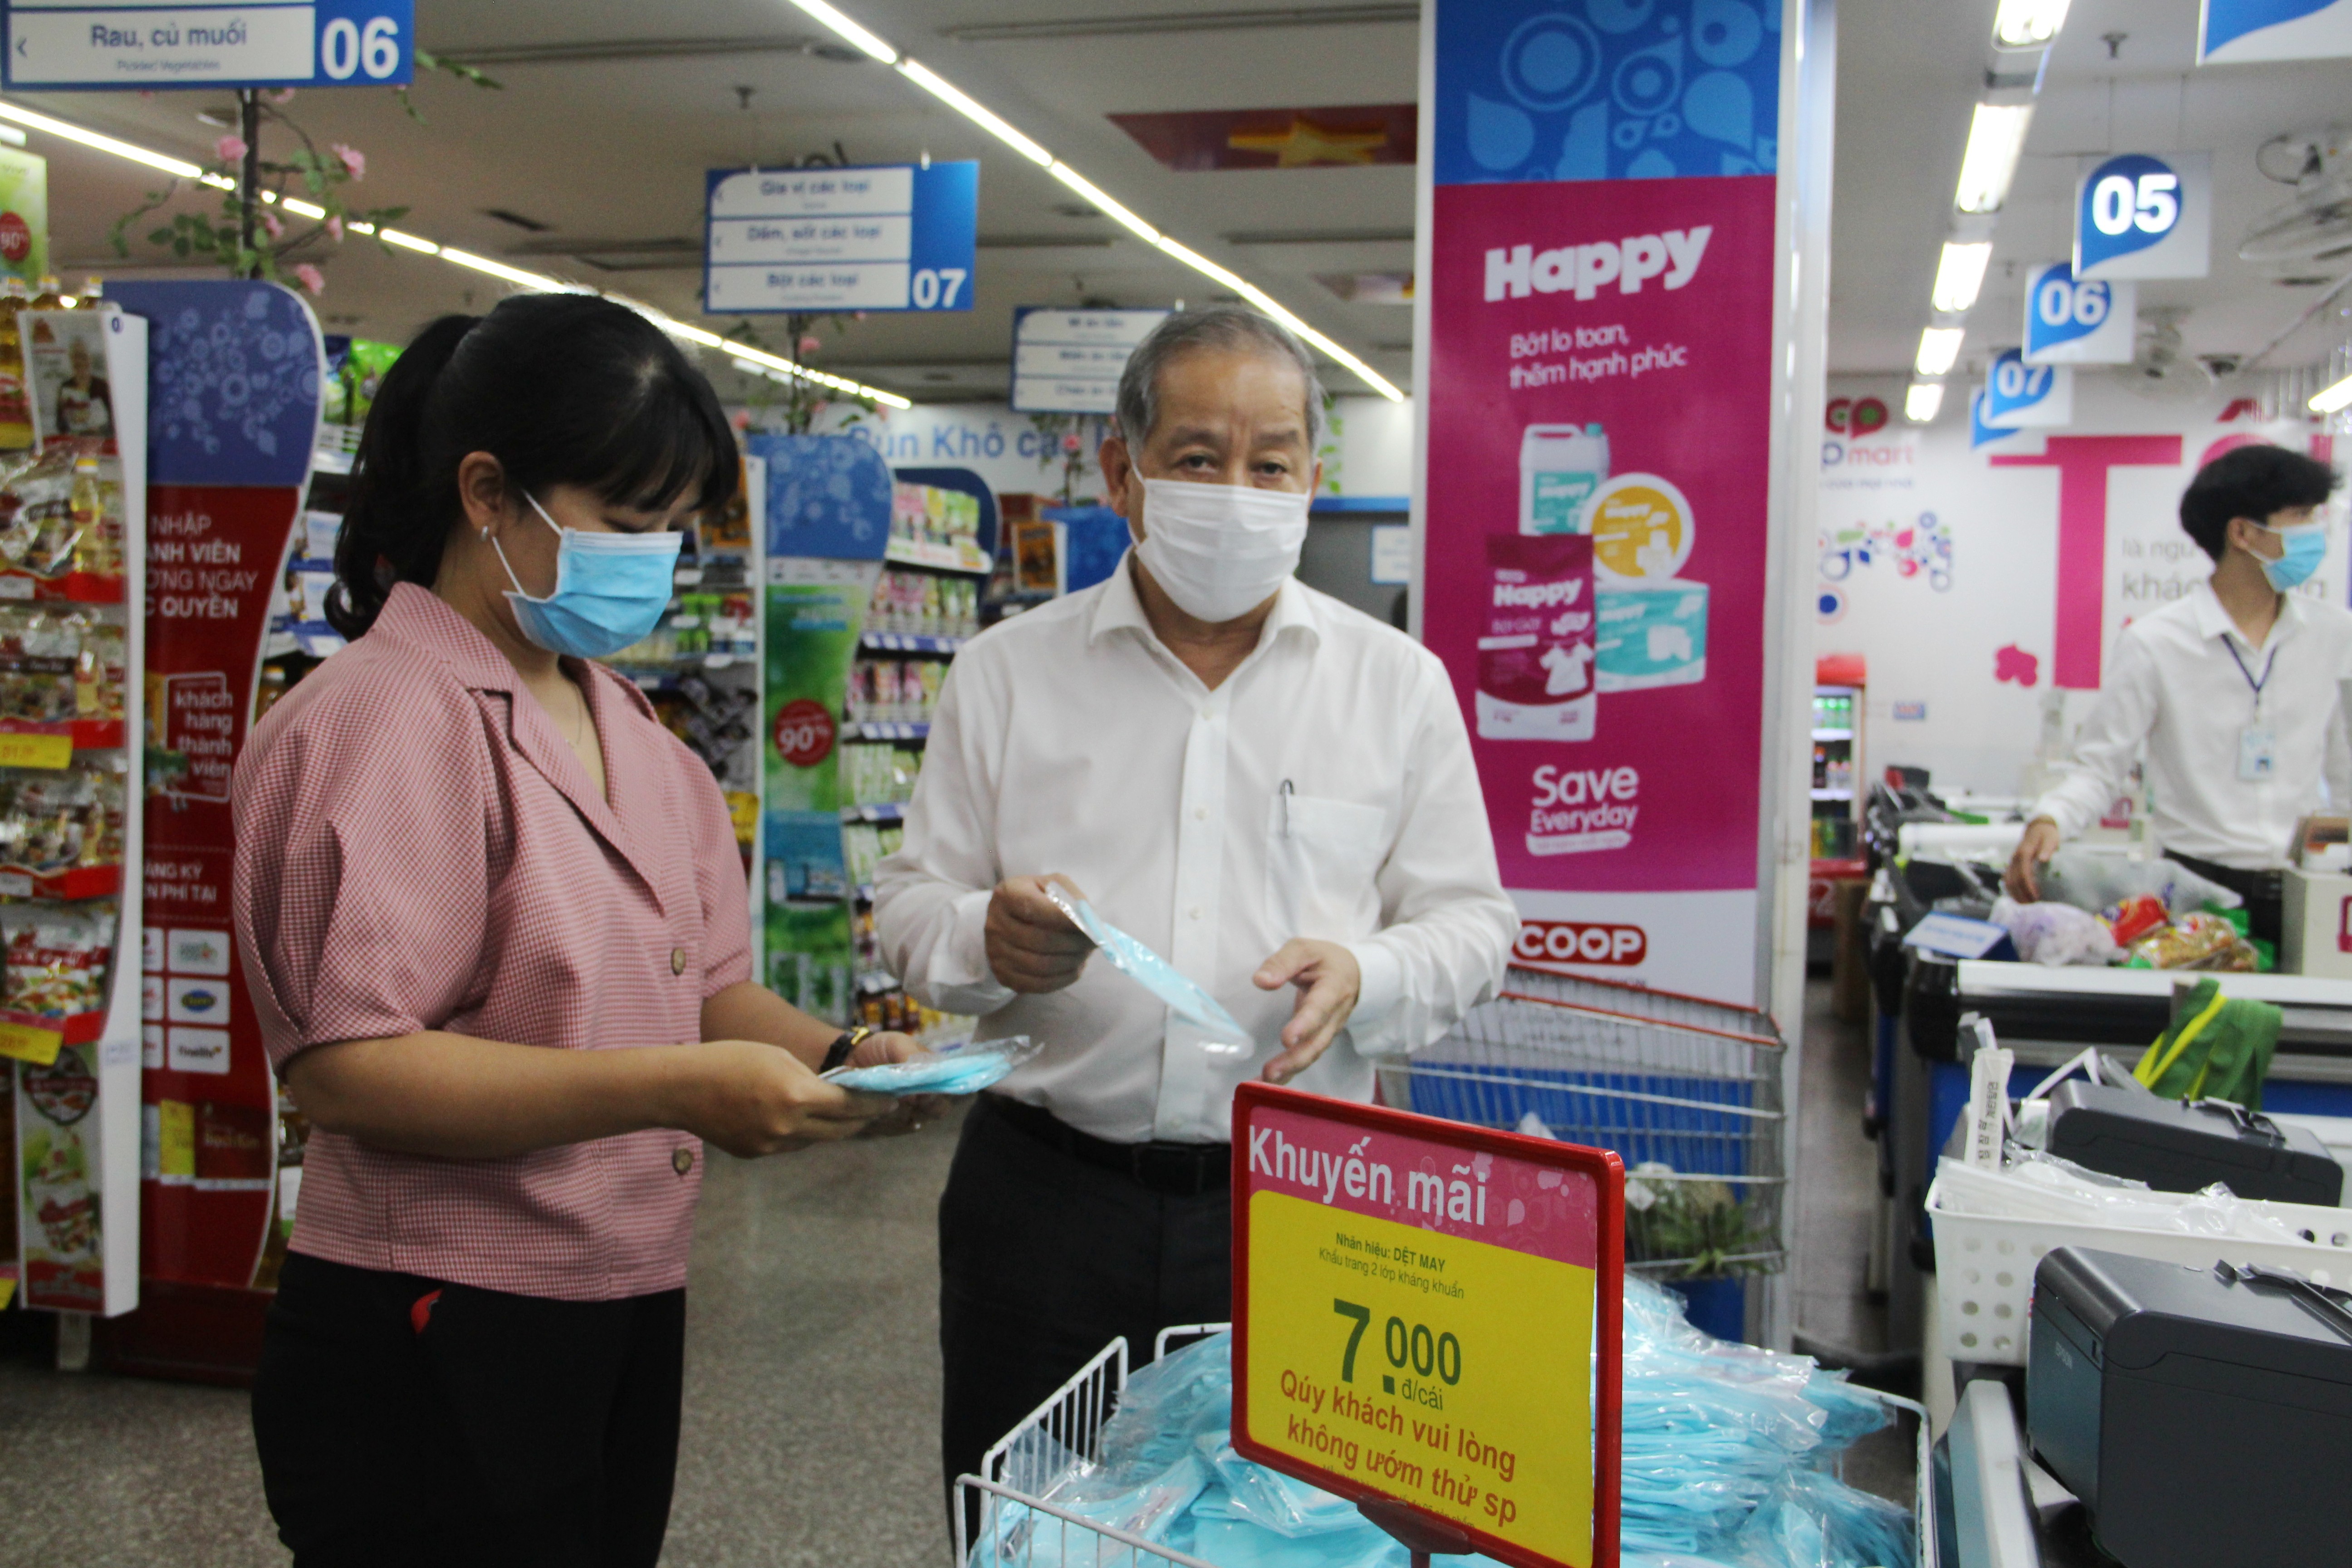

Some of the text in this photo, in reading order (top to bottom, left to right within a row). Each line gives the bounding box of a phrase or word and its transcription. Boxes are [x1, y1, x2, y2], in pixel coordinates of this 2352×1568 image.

[92, 17, 247, 51] Rau, củ muối
[321, 16, 401, 80] 06
[2092, 174, 2178, 235] 05
[1484, 224, 1714, 303] Happy
[912, 268, 967, 309] 07
[2038, 279, 2107, 327] 06
[1509, 323, 1631, 358] Bớt lo toan,
[1509, 343, 1688, 390] thêm hạnh phúc
[1996, 363, 2051, 397] 07
[190, 538, 241, 564] VIÊN
[199, 568, 260, 592] NGAY
[1493, 577, 1583, 610] Happy
[175, 690, 233, 709] khách
[184, 712, 233, 736] hàng
[176, 733, 233, 755] thành
[191, 759, 231, 776] viên
[1531, 764, 1640, 808] Save
[1530, 802, 1639, 834] Everyday
[1515, 924, 1642, 962] COOP
[1250, 1125, 1486, 1225] Khuyến mãi
[1336, 1232, 1446, 1273] Nhãn hiệu: DỆT MAY
[1319, 1246, 1465, 1299] Khẩu trang 2 lớp kháng khuẩn
[1401, 1378, 1443, 1411] đ/cái
[1280, 1369, 1516, 1483] Qúy khách vui lòng
[1288, 1413, 1359, 1471] không
[1366, 1449, 1423, 1489] ướm
[1431, 1468, 1478, 1507] thử
[1483, 1492, 1517, 1528] sp
